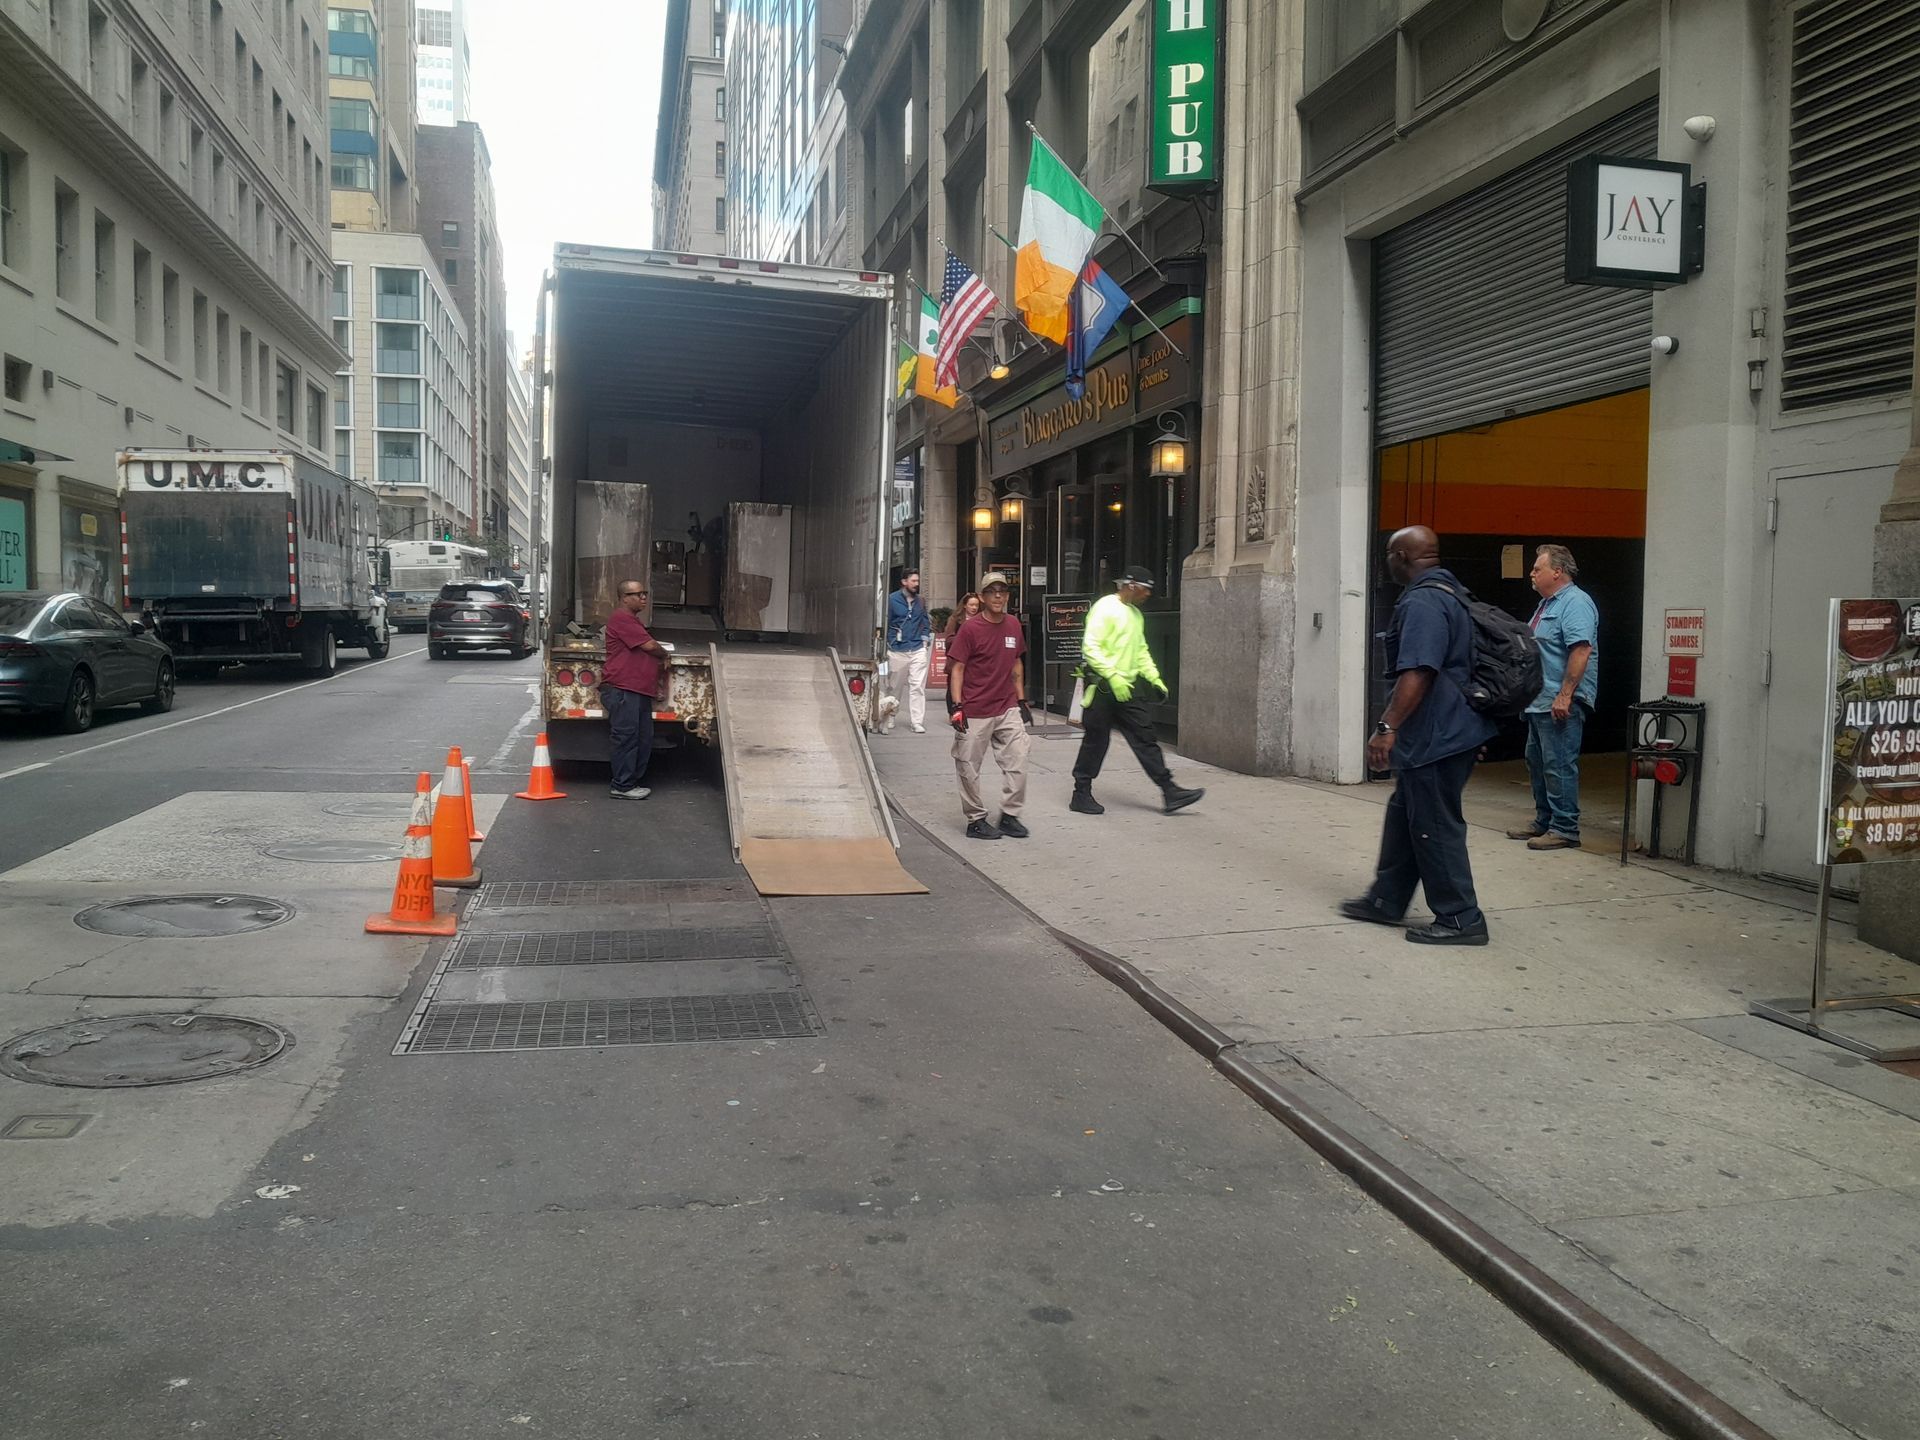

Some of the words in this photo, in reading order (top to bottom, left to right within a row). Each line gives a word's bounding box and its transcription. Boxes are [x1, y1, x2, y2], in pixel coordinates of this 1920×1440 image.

[1165, 63, 1205, 176] PUB
[1602, 193, 1675, 241] JAY
[1617, 234, 1666, 244] CONFERENCE
[1022, 391, 1093, 449] Blaggards
[144, 461, 273, 488] U.M.C.
[1667, 616, 1703, 629] STANDPIPE
[1670, 635, 1698, 648] SIAMESE
[1896, 676, 1920, 697] HOT
[1845, 701, 1873, 726] ALL
[1877, 700, 1909, 725] YOU
[1857, 765, 1897, 778] Everyday
[1847, 807, 1862, 821] ALL
[1864, 807, 1881, 820] YOU
[1882, 806, 1900, 819] CAN
[1866, 823, 1903, 844] $8.99
[397, 893, 430, 912] DEP
